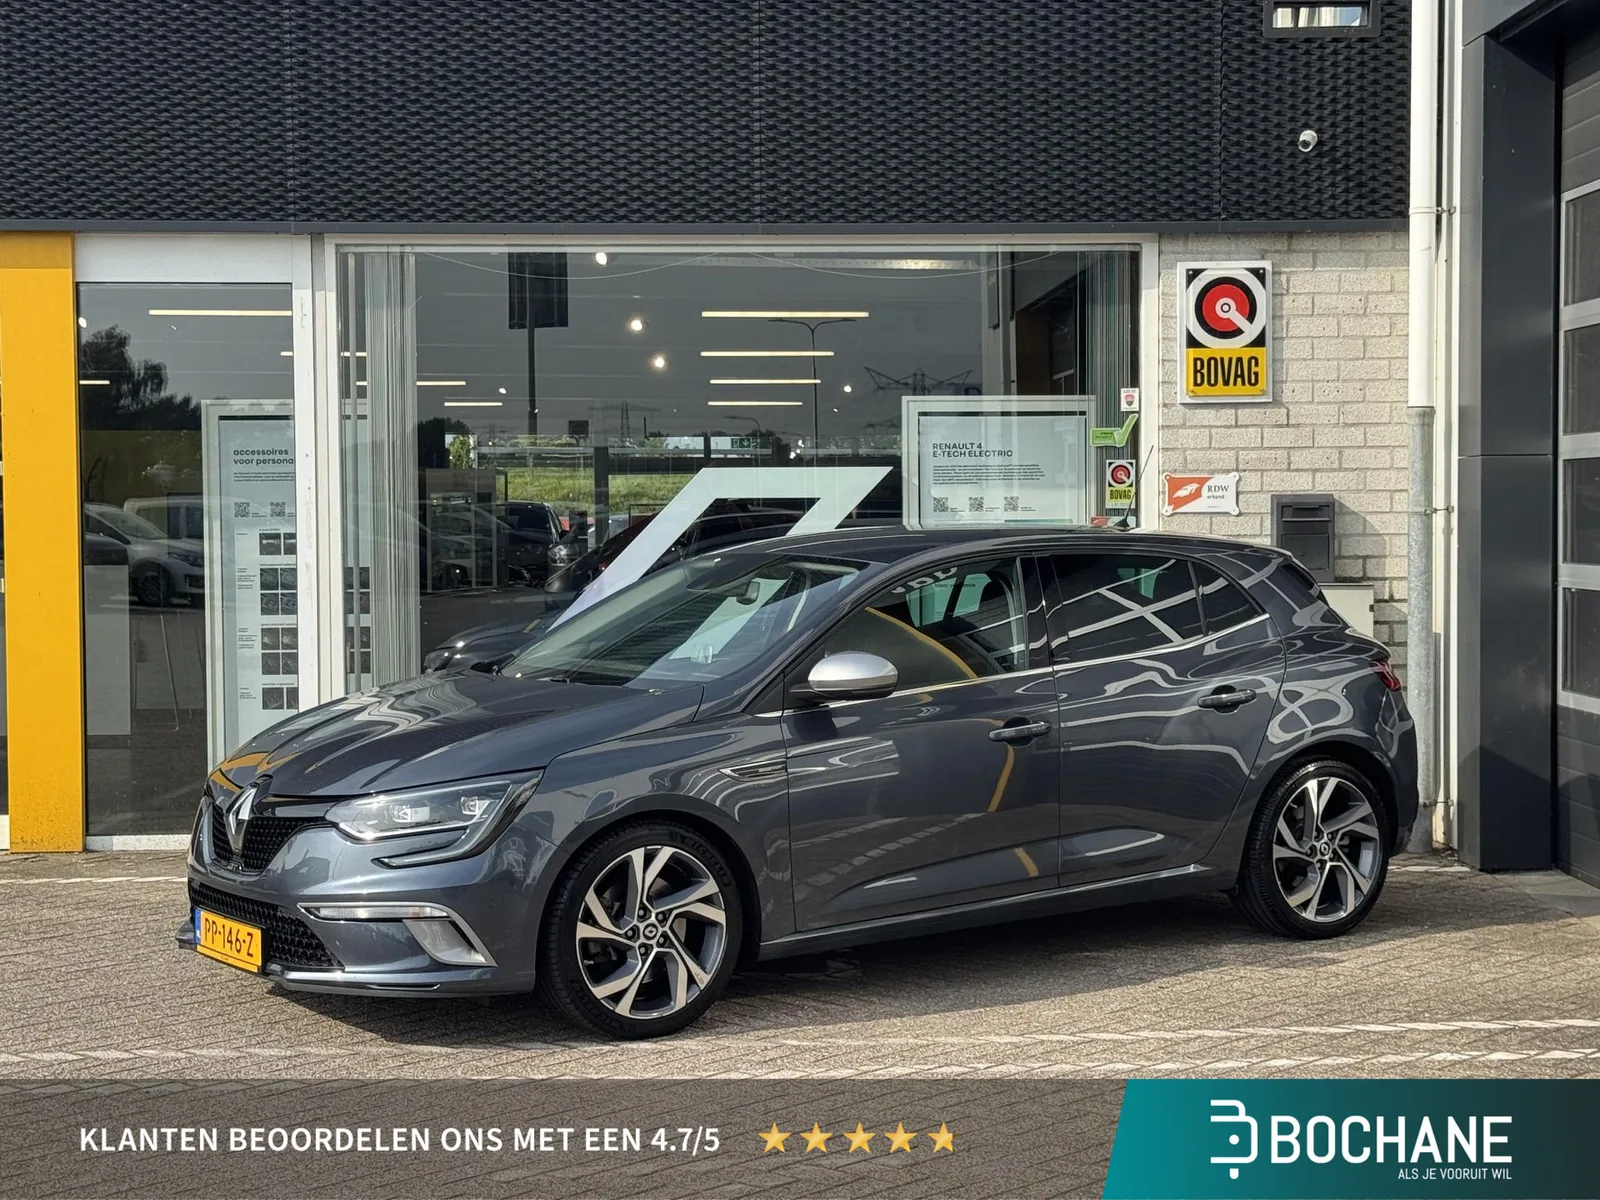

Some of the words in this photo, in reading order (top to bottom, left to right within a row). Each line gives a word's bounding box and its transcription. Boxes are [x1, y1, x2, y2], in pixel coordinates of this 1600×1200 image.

[1193, 356, 1259, 387] BOVAG
[932, 442, 975, 450] RENAULT
[233, 447, 289, 456] accessoires
[932, 450, 967, 458] E-TECH
[968, 450, 1014, 458] ELECTRIC
[1207, 484, 1230, 493] RDW
[1109, 489, 1132, 501] BOVAG
[204, 917, 254, 958] PP-146-Z
